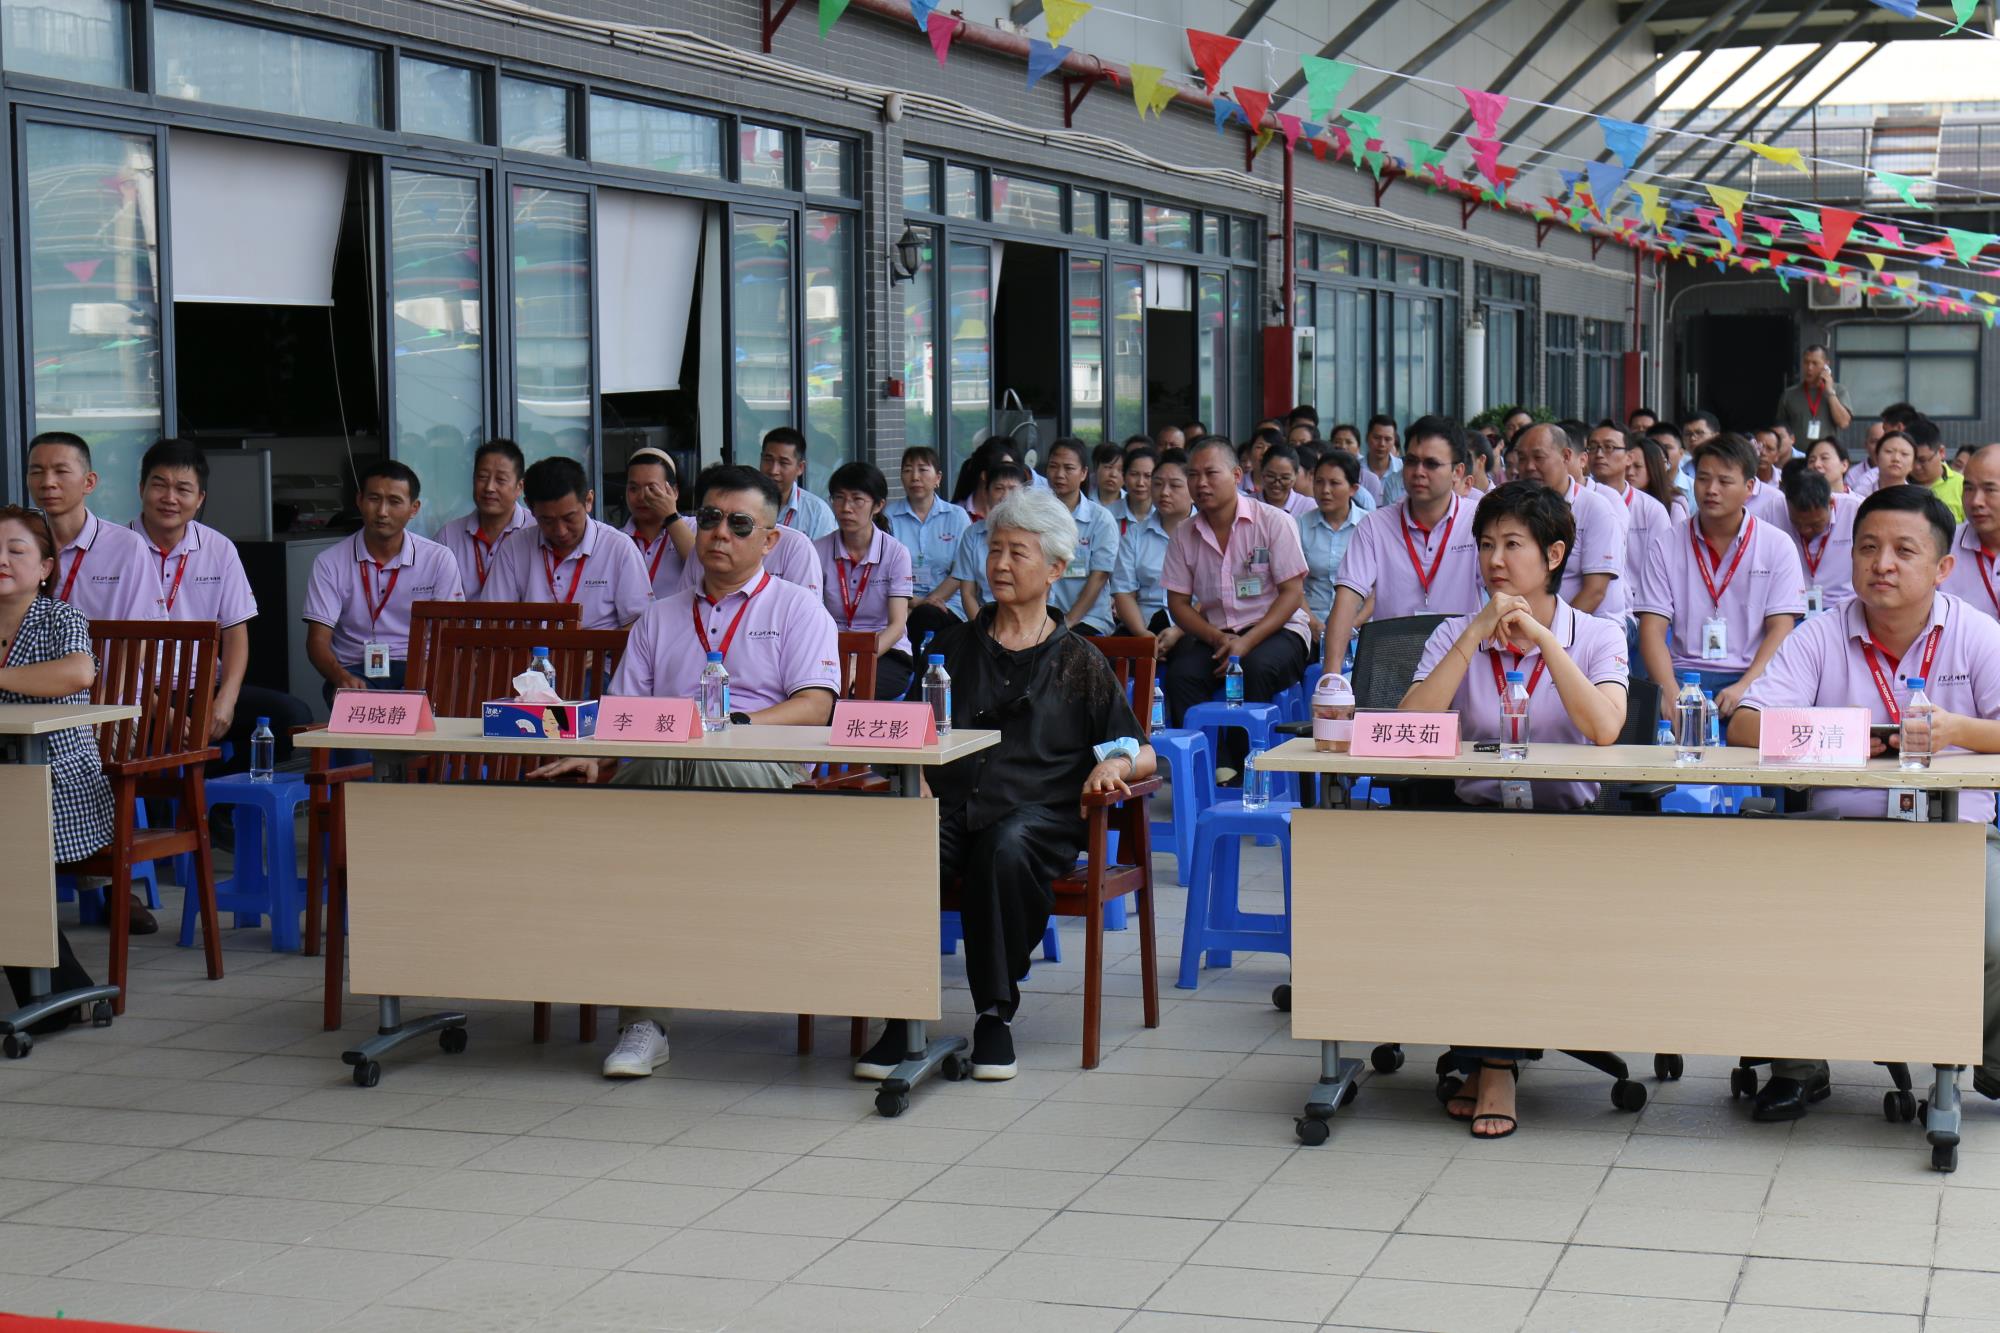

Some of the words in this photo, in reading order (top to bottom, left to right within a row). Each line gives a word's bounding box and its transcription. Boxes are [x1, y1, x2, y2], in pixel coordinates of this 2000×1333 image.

[348, 705, 407, 725] 冯晓静
[846, 718, 909, 740] 张艺影
[1371, 722, 1441, 745] 郭英茹
[1790, 724, 1844, 750] 罗清
